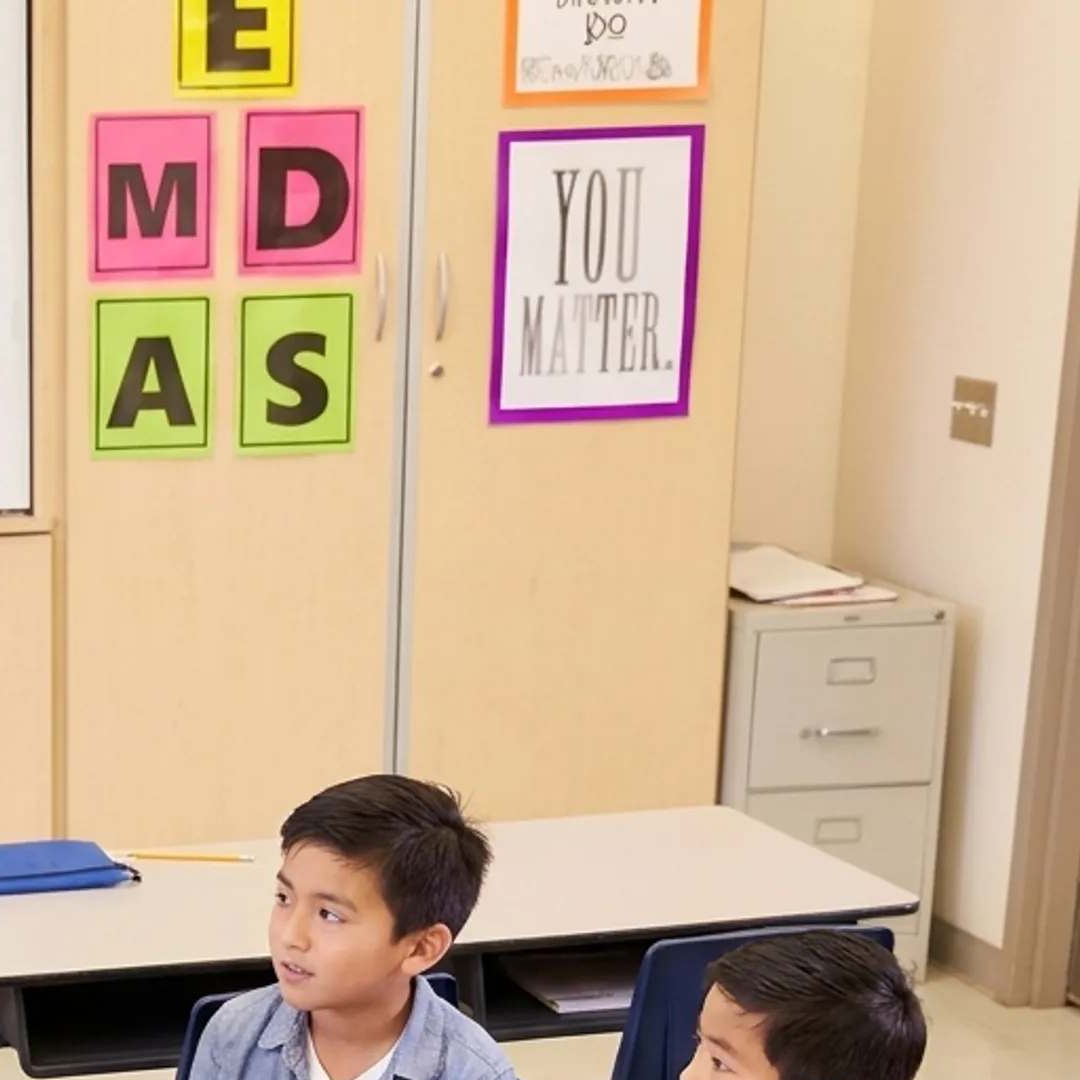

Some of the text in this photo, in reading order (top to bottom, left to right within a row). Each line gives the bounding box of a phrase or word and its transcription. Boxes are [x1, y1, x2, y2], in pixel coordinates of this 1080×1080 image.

[206, 0, 271, 72] E
[108, 162, 197, 239] M
[256, 147, 350, 251] D
[552, 166, 645, 286] YOU
[266, 332, 329, 427] S
[519, 292, 674, 377] MATTER.
[106, 336, 196, 429] A
